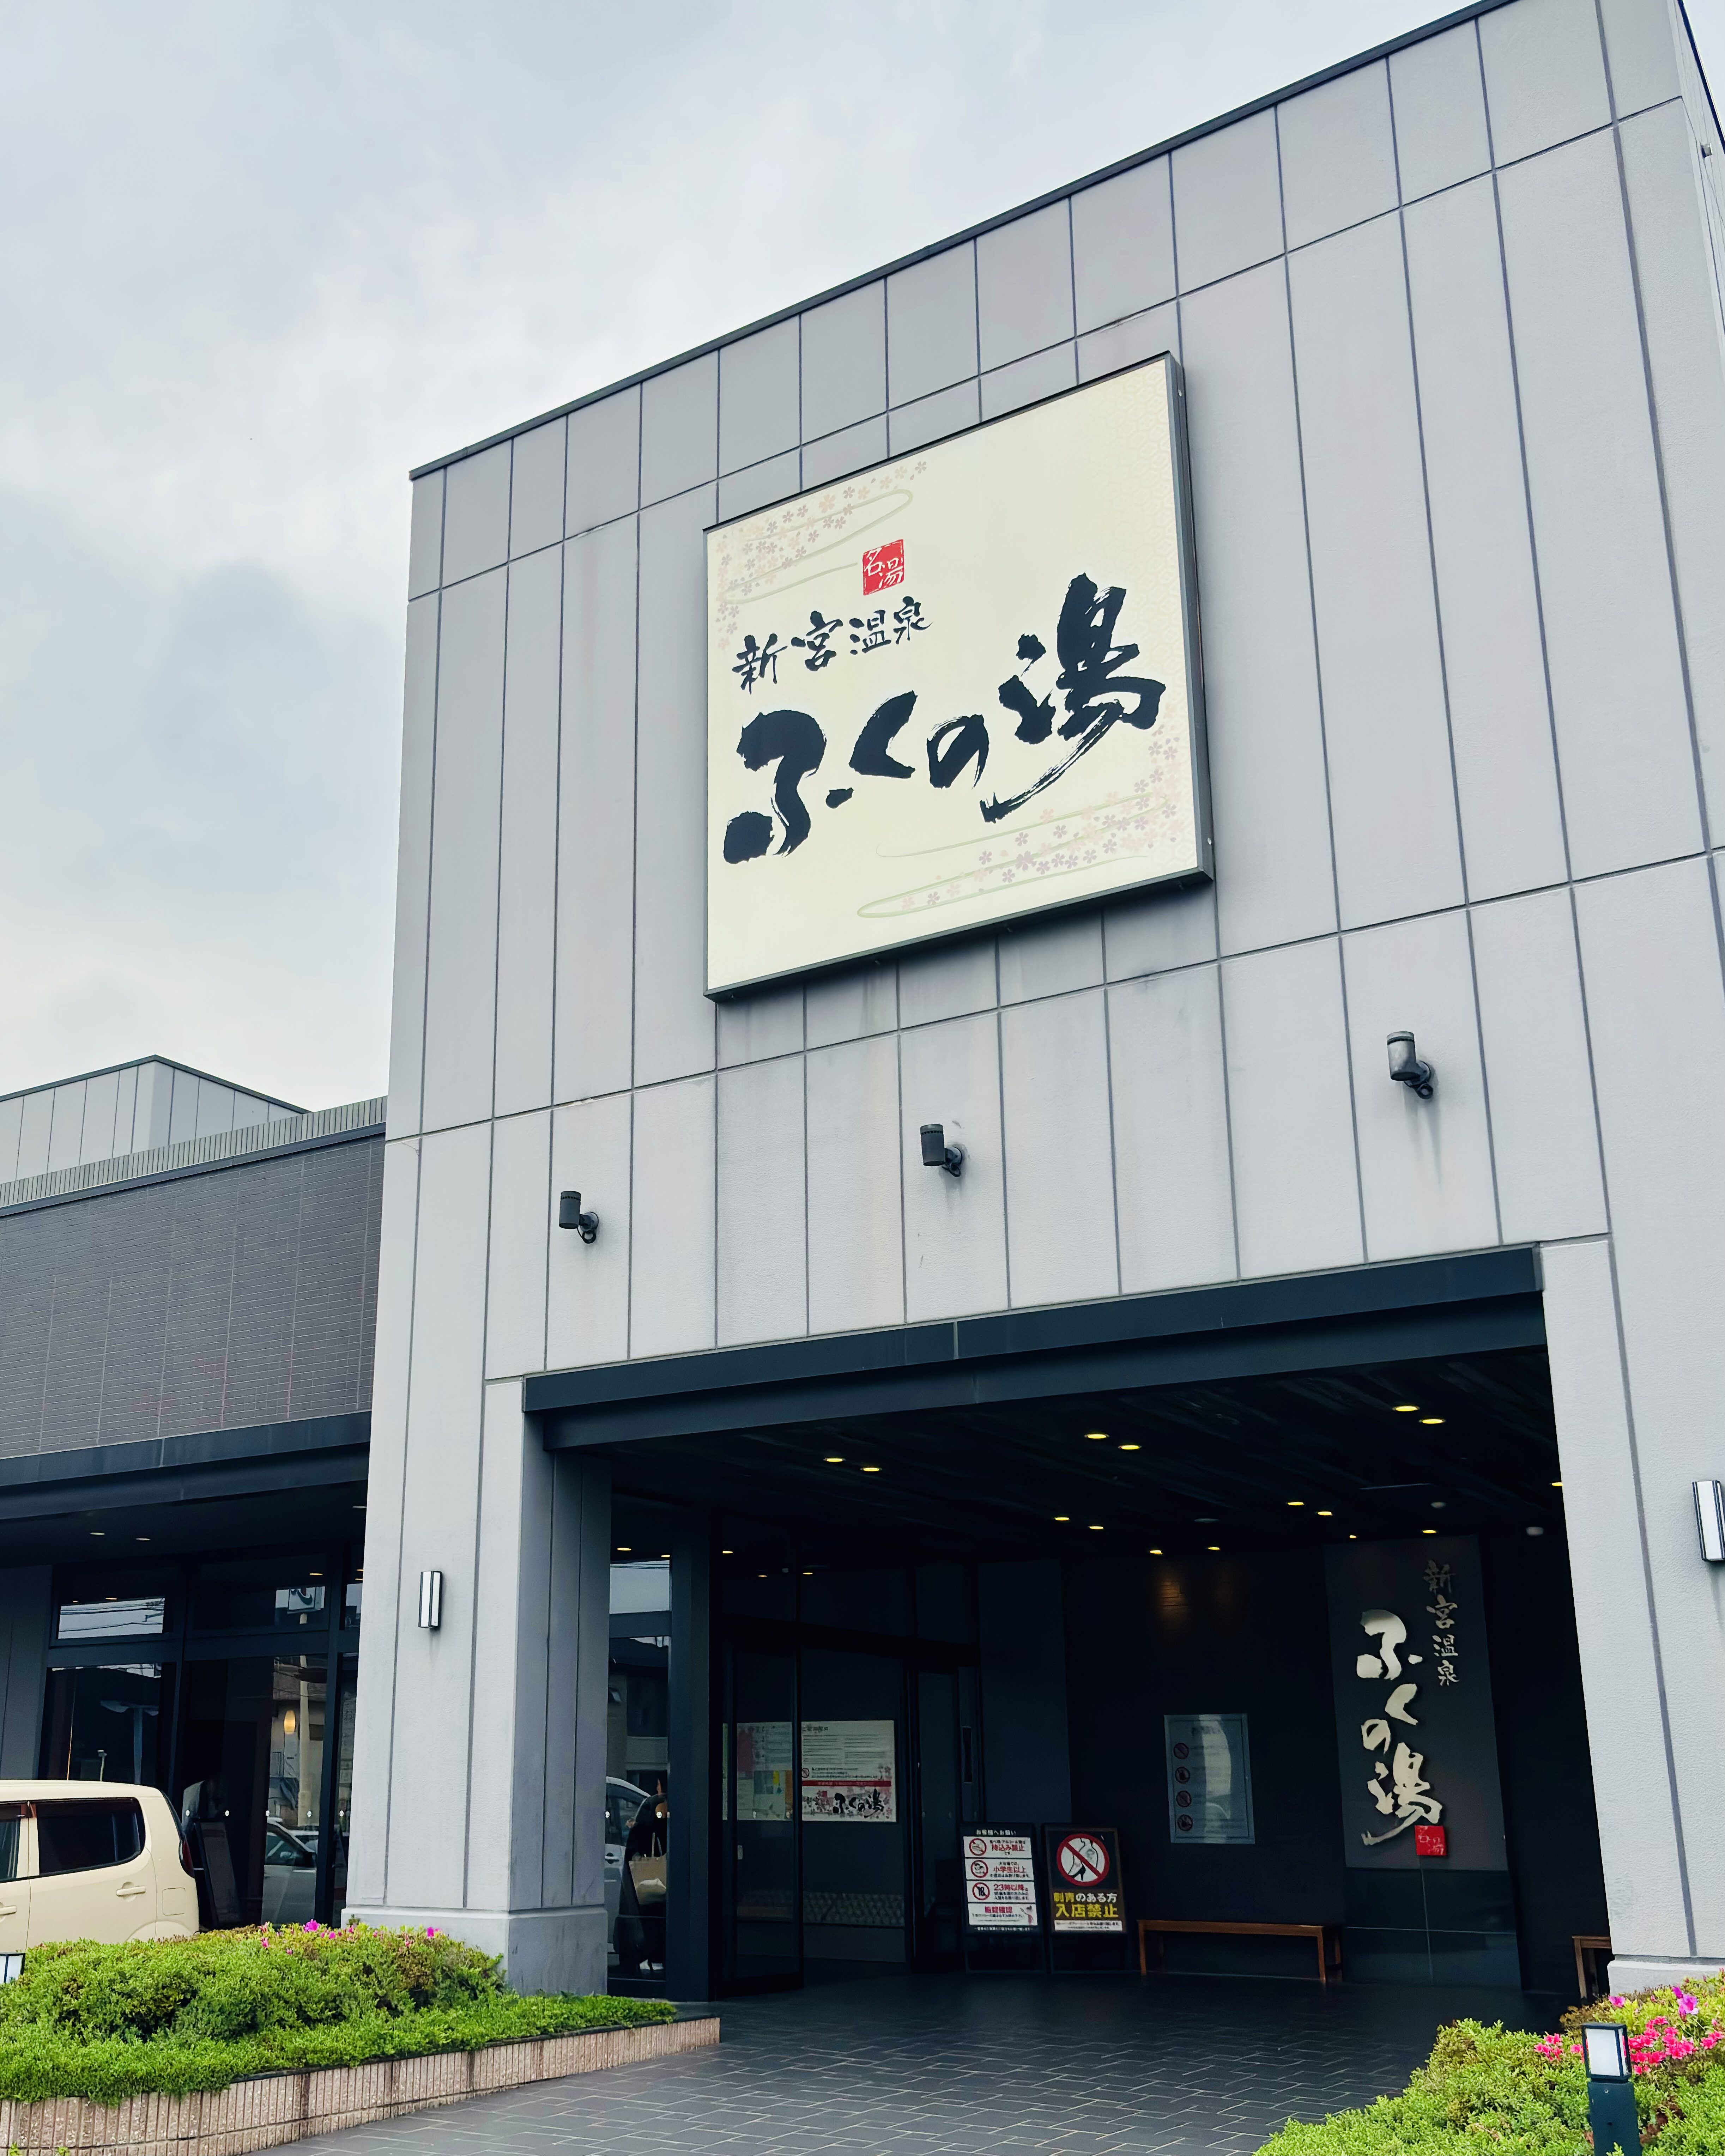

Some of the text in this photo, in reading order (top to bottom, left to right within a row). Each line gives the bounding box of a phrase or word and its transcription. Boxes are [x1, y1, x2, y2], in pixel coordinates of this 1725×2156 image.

[864, 546, 903, 582] 名湯
[732, 596, 933, 694] 新宮温泉
[723, 572, 1166, 864] ふくの湯
[1423, 1560, 1459, 1686] 新宮温泉
[1356, 1609, 1443, 1846] ふくの湯
[1053, 1892, 1118, 1903] 刺青のある方
[1056, 1903, 1119, 1918] 入店禁止
